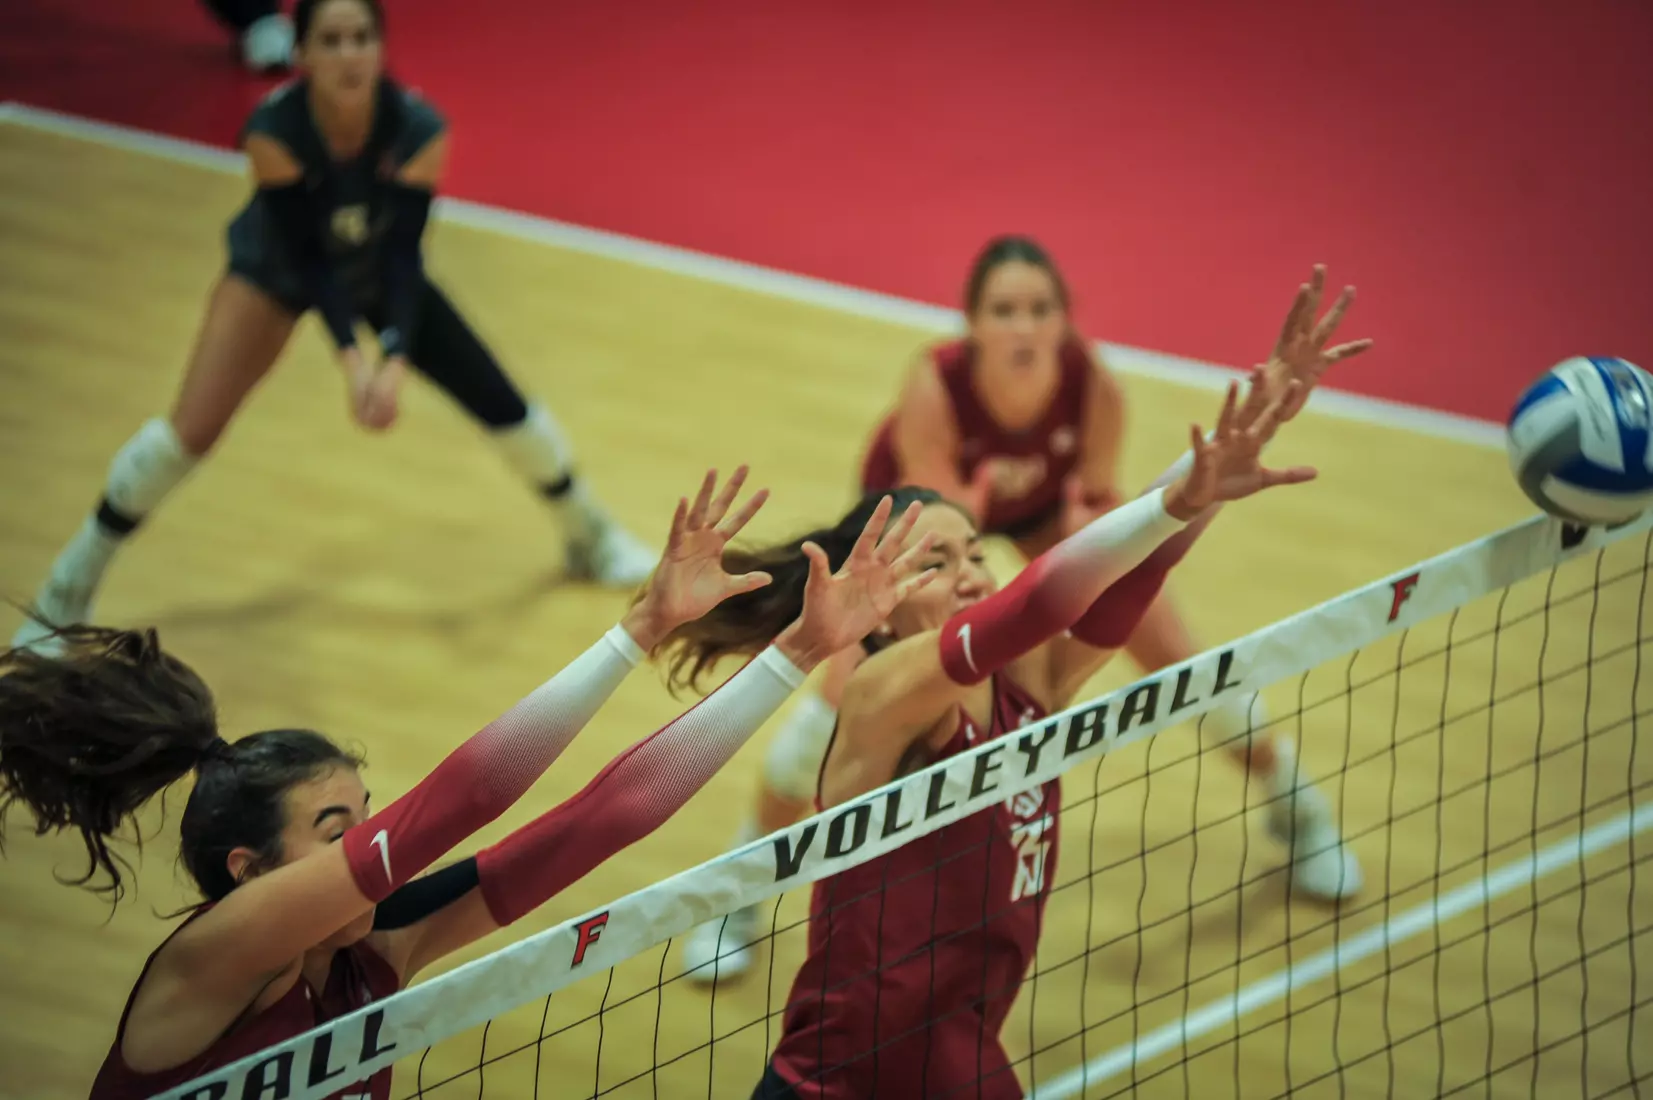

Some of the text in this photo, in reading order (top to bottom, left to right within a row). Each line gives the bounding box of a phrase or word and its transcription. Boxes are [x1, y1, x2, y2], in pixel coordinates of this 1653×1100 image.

[1387, 572, 1420, 624] F
[773, 650, 1241, 882] VOLLEYBALL
[570, 910, 609, 969] F
